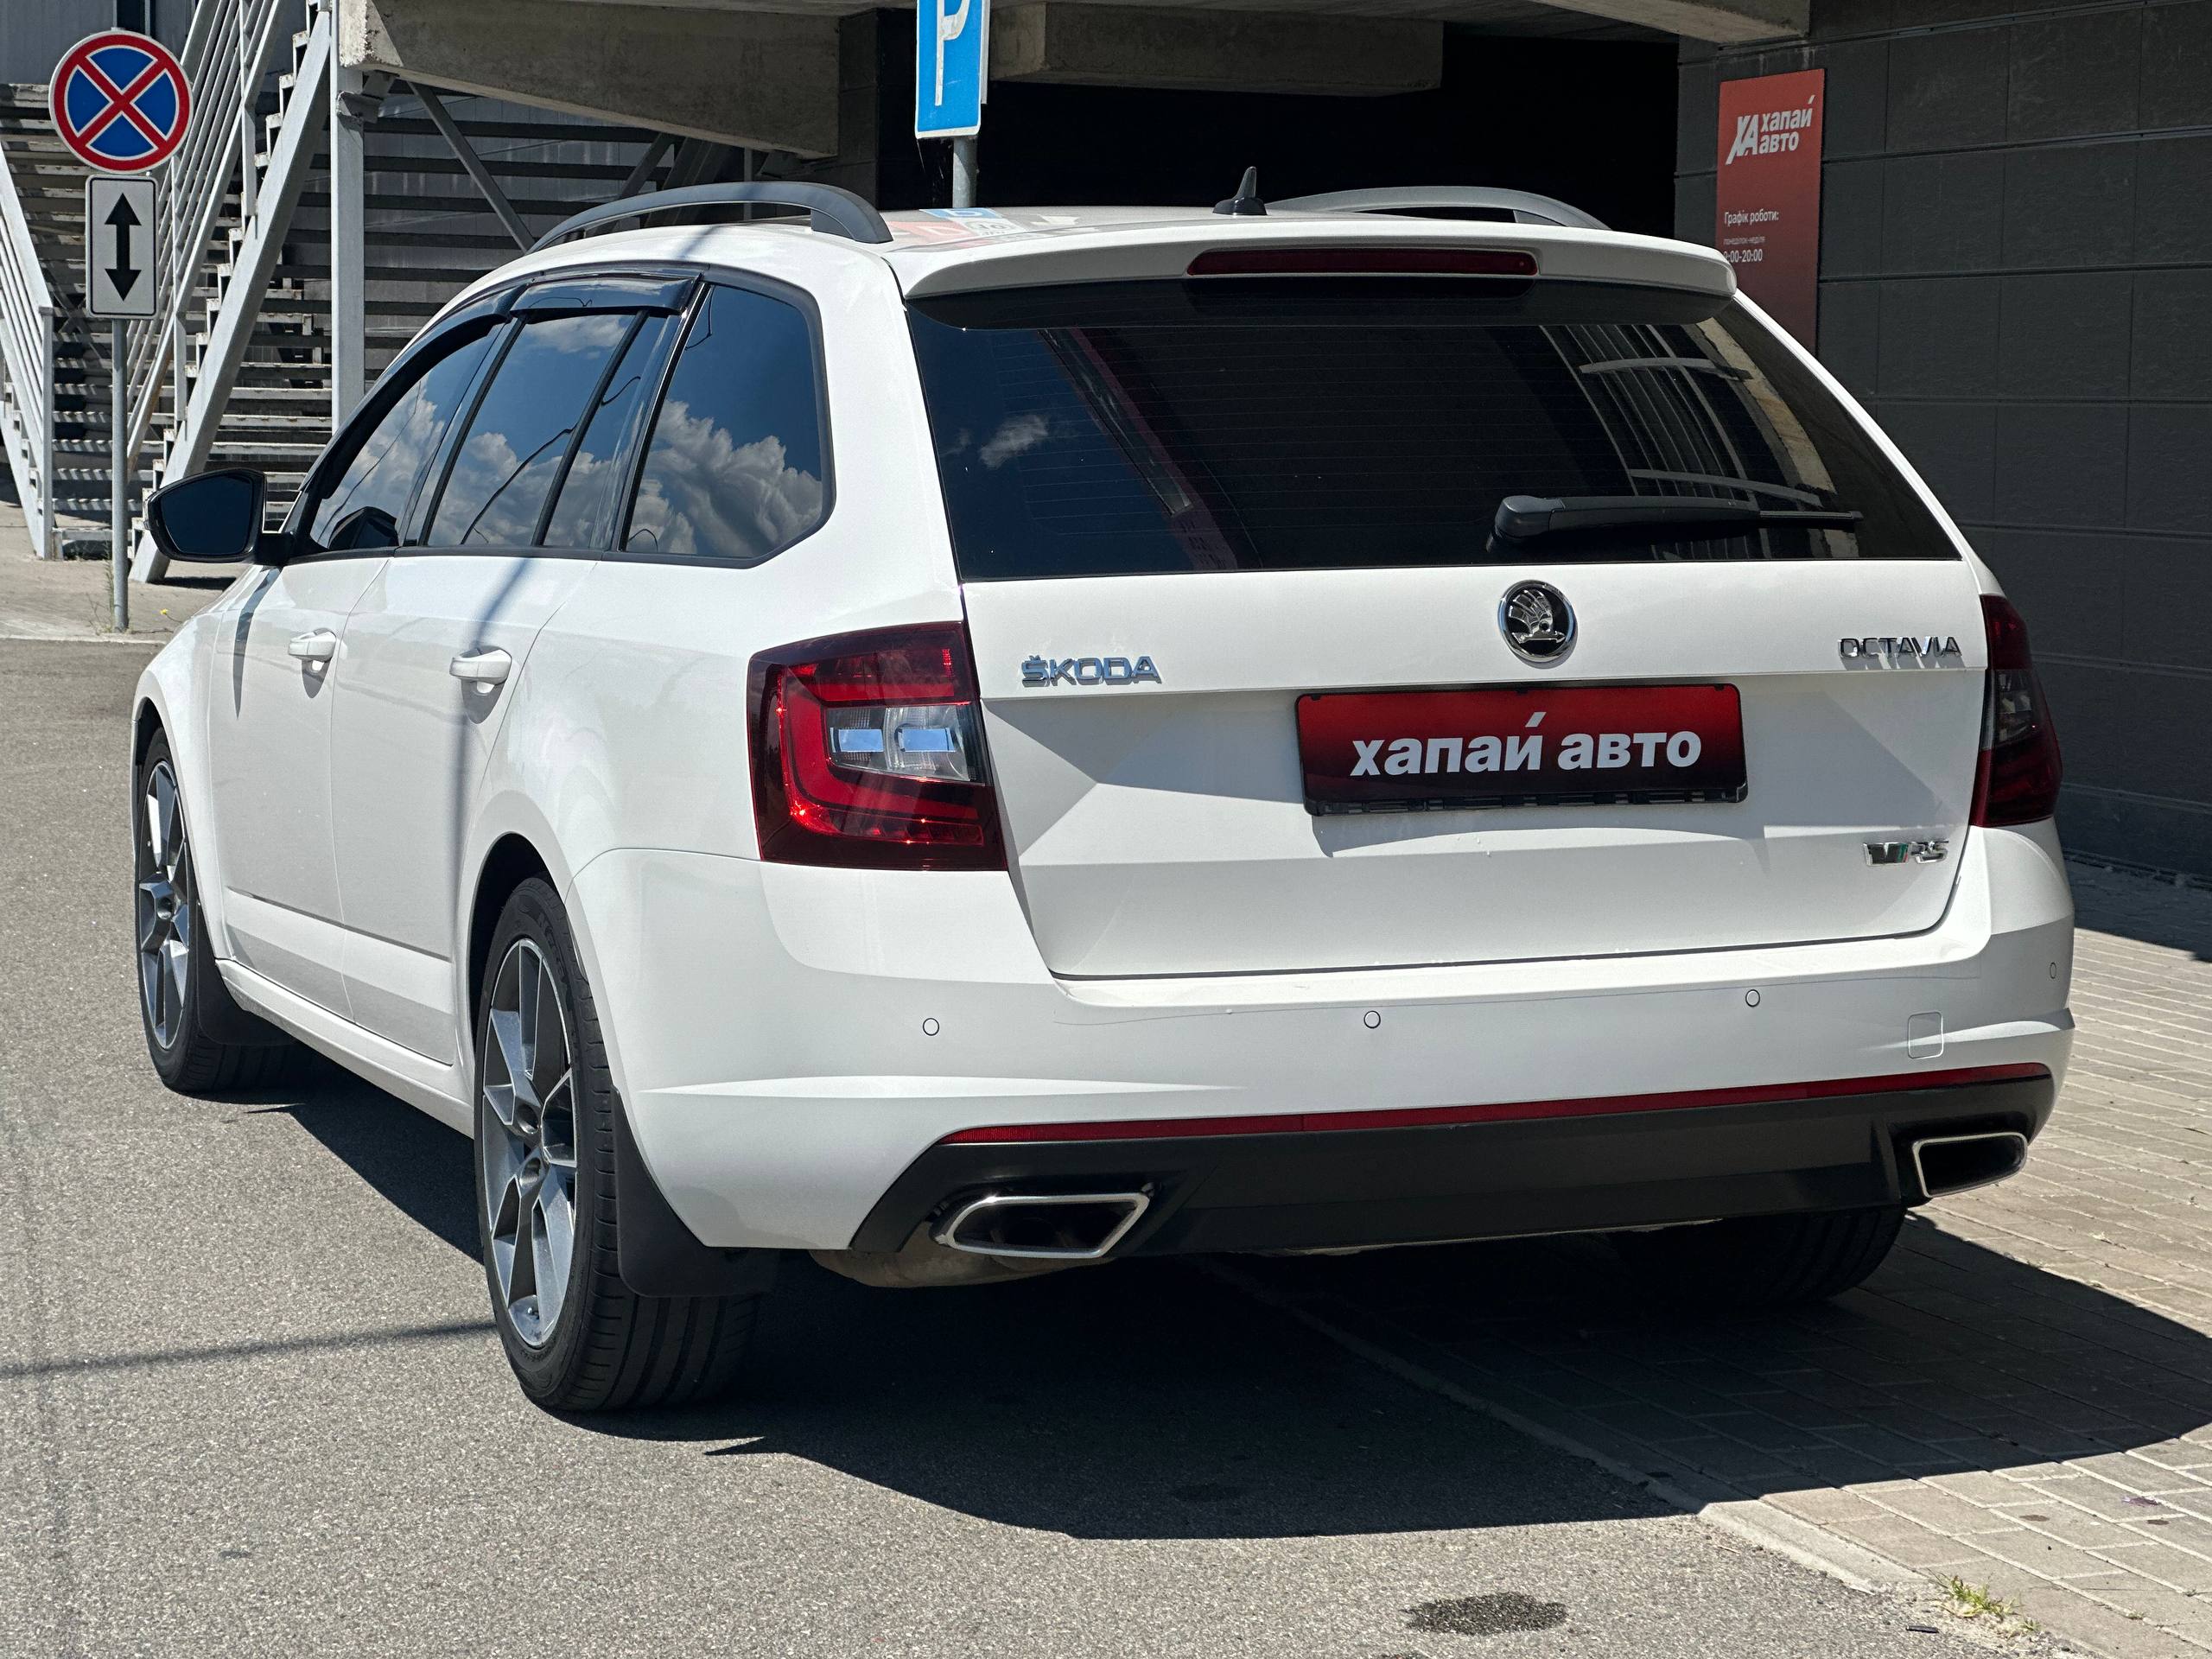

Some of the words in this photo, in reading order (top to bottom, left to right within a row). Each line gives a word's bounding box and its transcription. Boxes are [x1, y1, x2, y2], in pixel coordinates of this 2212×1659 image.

[1760, 94, 1815, 133] хапай
[1758, 130, 1799, 154] авто
[1724, 210, 1749, 226] Графік
[1750, 208, 1780, 226] роботи:
[1838, 635, 1962, 658] OCTAVIA
[1021, 655, 1163, 688] ŠKODA
[1350, 711, 1547, 777] хапай
[1557, 730, 1702, 771] авто
